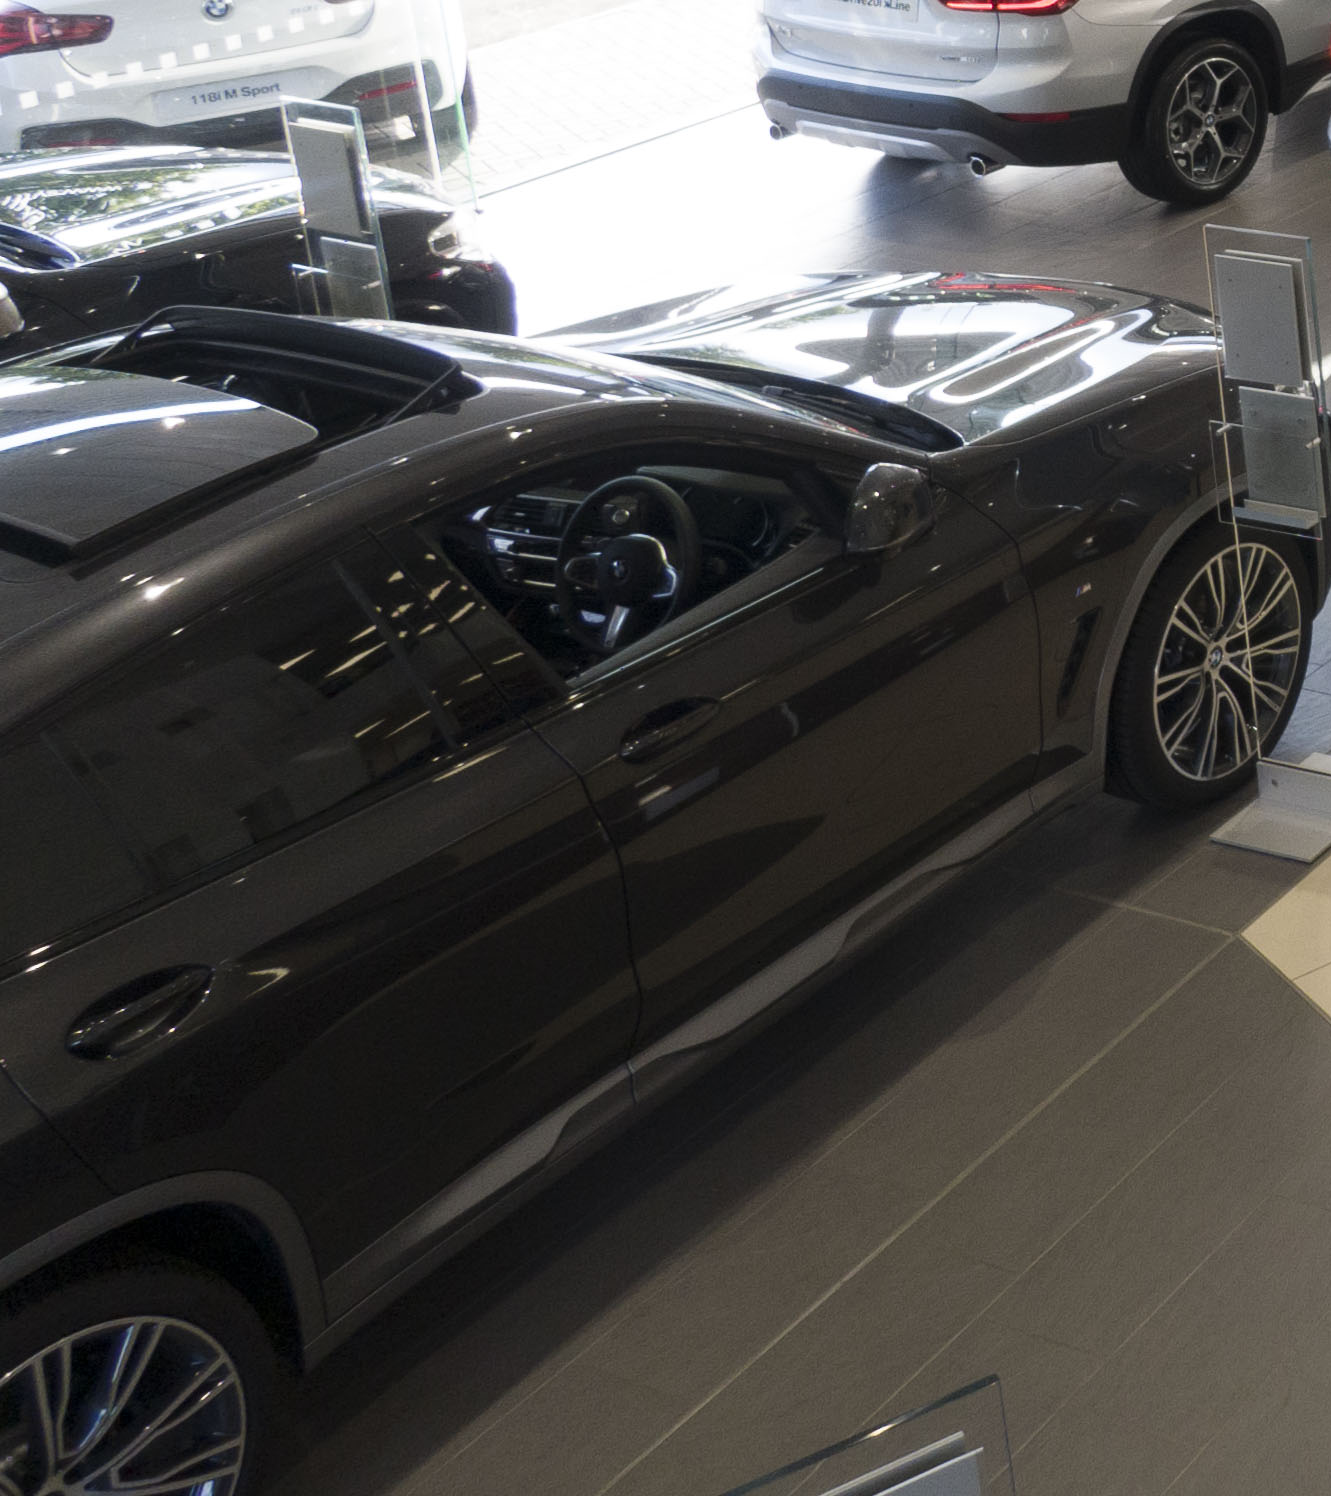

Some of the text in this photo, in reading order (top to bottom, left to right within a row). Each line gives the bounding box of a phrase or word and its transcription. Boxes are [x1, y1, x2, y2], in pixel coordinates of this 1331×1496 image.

[191, 83, 281, 105] 118i M Sport
